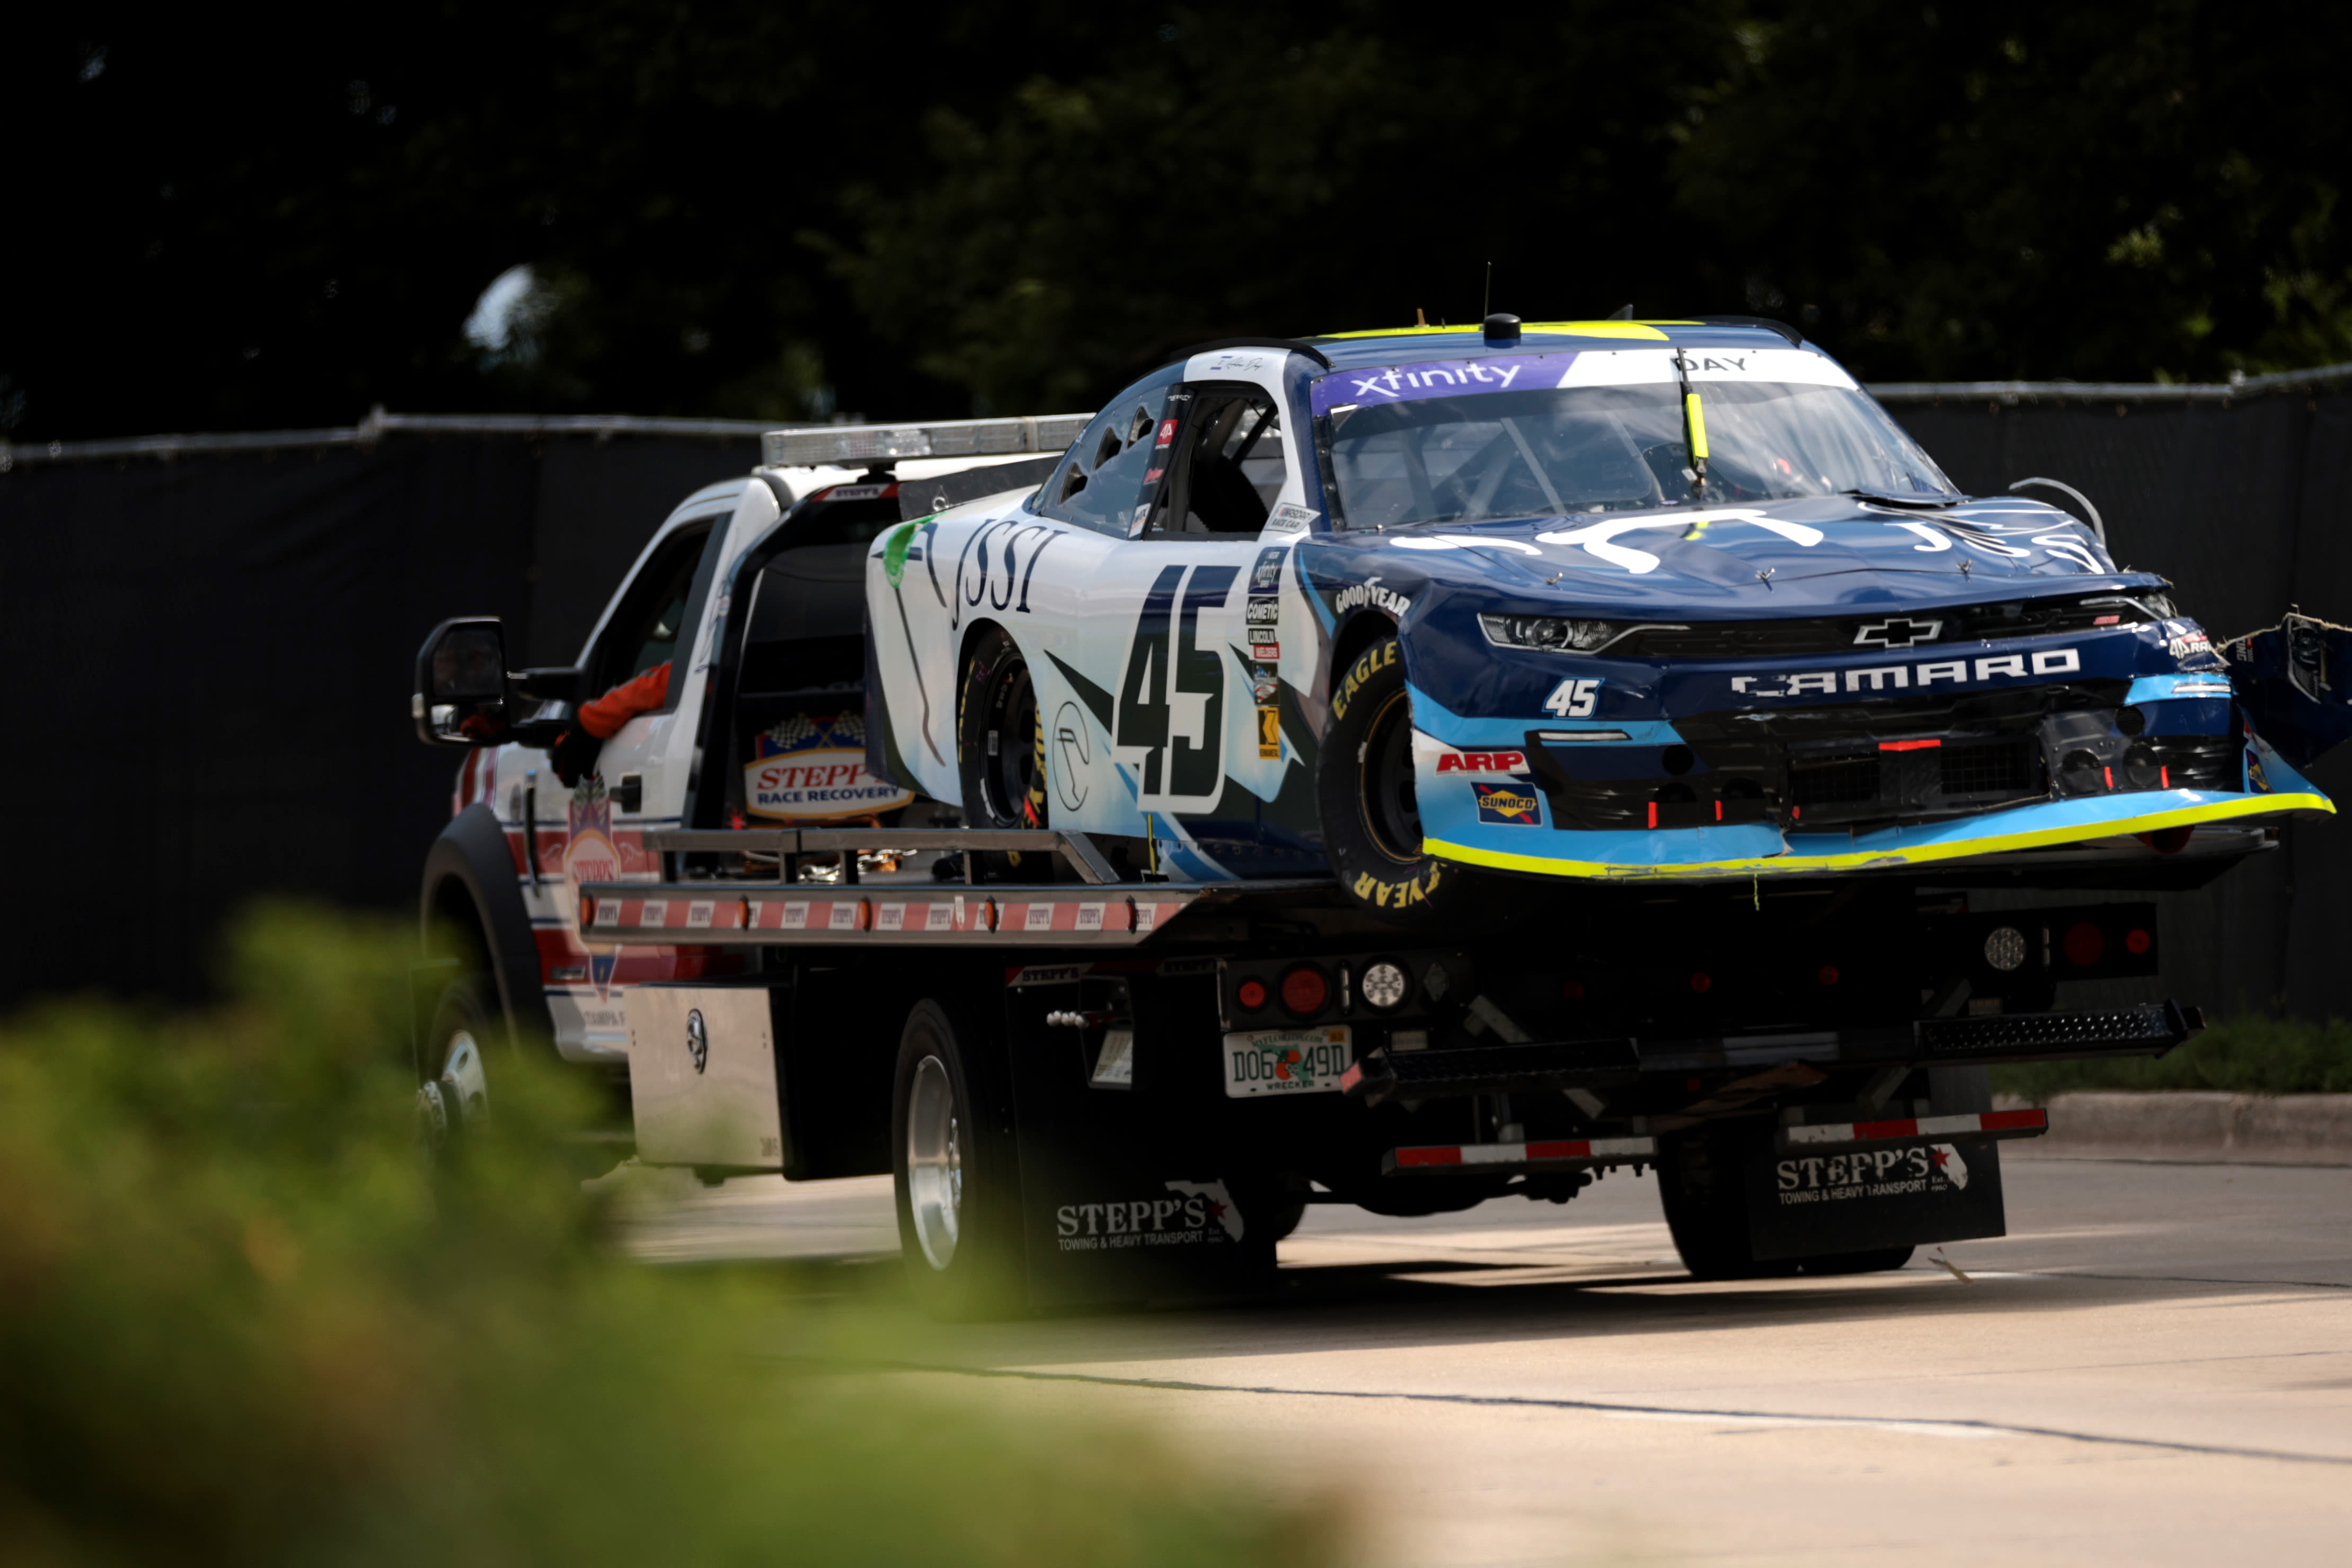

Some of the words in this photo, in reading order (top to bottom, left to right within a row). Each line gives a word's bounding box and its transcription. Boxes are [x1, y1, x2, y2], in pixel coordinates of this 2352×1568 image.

[1677, 358, 1746, 371] DAY
[1351, 364, 1520, 397] xfinity
[1336, 577, 1411, 617] GOODYEAR
[1248, 603, 1278, 619] COMETIC
[1250, 630, 1275, 644] LINCOLN
[1116, 565, 1242, 805] 45
[1332, 641, 1397, 721] EAGLE
[1544, 679, 1601, 717] 45
[1436, 751, 1524, 772] ARP
[758, 792, 802, 804] RACE
[808, 786, 900, 801] RECOVERY
[1482, 796, 1534, 809] SUNOCO
[1023, 968, 1078, 981] STEPP'S
[1267, 1080, 1314, 1089] WRECKER
[1776, 1147, 1929, 1191] STEPP'S
[1779, 1190, 1819, 1206] TOWING
[1821, 1189, 1829, 1201] &
[1831, 1185, 1864, 1200] HEAVY
[1057, 1198, 1207, 1236] STEPP'S
[1058, 1237, 1098, 1251] TOWING
[1100, 1236, 1108, 1249] &
[1109, 1234, 1141, 1248] HEAVY
[1144, 1229, 1204, 1245] TRANSPORT
